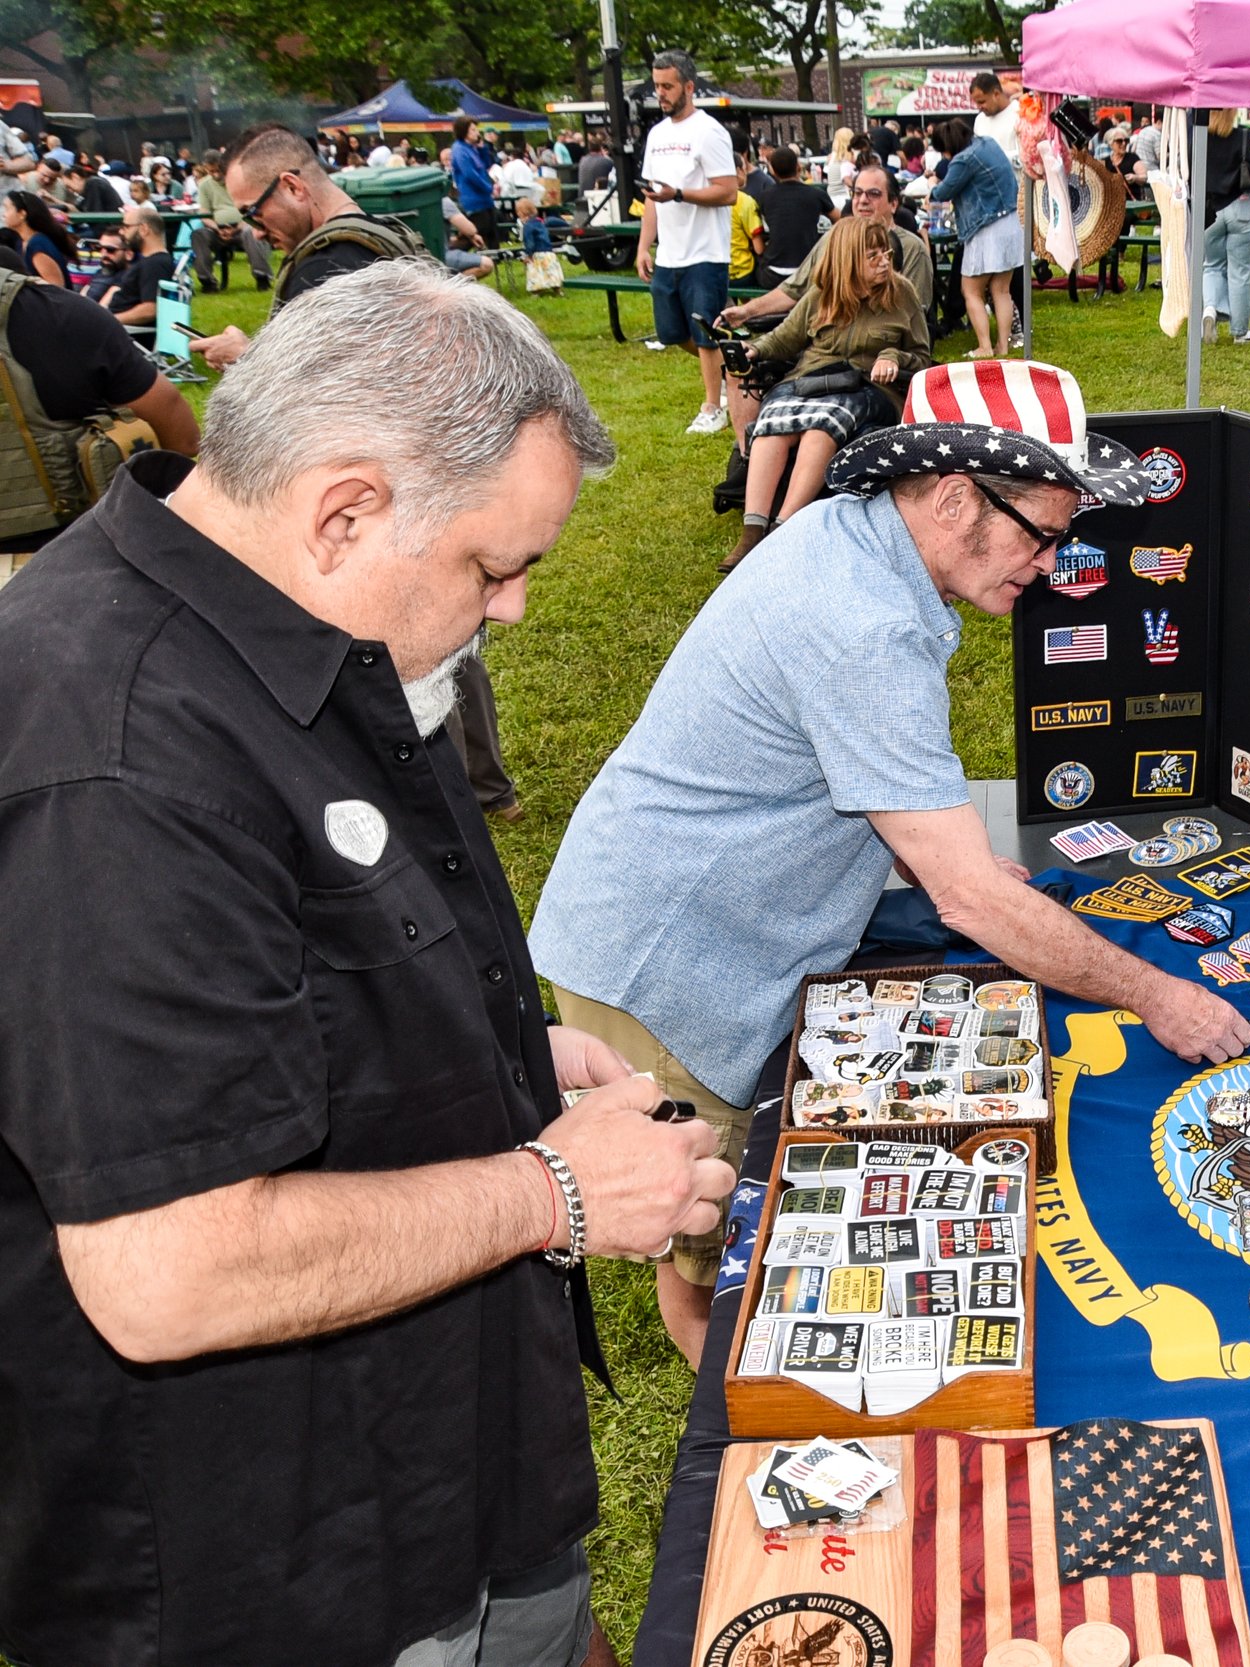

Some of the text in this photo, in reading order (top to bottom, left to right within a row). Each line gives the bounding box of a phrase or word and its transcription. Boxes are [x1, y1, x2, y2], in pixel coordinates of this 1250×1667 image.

[1056, 555, 1105, 571] REEDOM
[1078, 567, 1107, 583] FREE
[1040, 707, 1103, 725] U.S. NAVY
[1134, 699, 1195, 715] U.S. NAVY
[1121, 882, 1144, 897] U.S.
[1145, 890, 1183, 904] NAVY
[1129, 900, 1164, 911] NAVY
[1179, 910, 1229, 939] FREEDOM
[1190, 927, 1216, 944] FREE
[868, 1156, 931, 1166] GOOD STORIES
[871, 1143, 935, 1153] BAD DECISIONS
[888, 1150, 913, 1158] MAKE
[871, 1181, 882, 1209] EFFORT
[888, 1176, 900, 1213] MAXIMUM
[918, 1172, 946, 1209] THE ONE
[942, 1173, 970, 1208] I'M NOT
[854, 1230, 868, 1254] ALONE
[869, 1224, 884, 1259] LEAVE ME
[899, 1229, 912, 1247] LIVE
[964, 1221, 974, 1237] BUT
[1002, 1221, 1011, 1236] MAY
[803, 1232, 820, 1254] LET ME
[817, 1248, 830, 1257] ON
[966, 1242, 976, 1253] DO
[1003, 1238, 1014, 1254] NOT
[843, 1271, 852, 1280] NO
[1049, 1237, 1124, 1303] NAVY
[914, 1274, 928, 1313] NOT TDAY
[930, 1273, 955, 1313] NOPE
[977, 1264, 992, 1306] YOU DIE?
[996, 1266, 1013, 1304] BUT DID
[840, 1293, 849, 1309] WHAT
[754, 1323, 771, 1341] STAY
[885, 1327, 902, 1364] BROKE
[905, 1324, 915, 1366] BECAUSE YOU
[917, 1325, 931, 1363] I'M HERE
[952, 1317, 970, 1366] GETS WORSE
[968, 1319, 986, 1363] BEFORE IT
[985, 1324, 1001, 1356] WORSE
[1000, 1324, 1016, 1357] IT GETS
[746, 1344, 765, 1369] WEIRD
[788, 1327, 813, 1366] DRIVER
[836, 1326, 860, 1369] WEE WOO
[872, 1328, 882, 1367] SOMETHING
[708, 1601, 781, 1667] FORT HAMILTO
[807, 1597, 886, 1649] UNITED STATES
